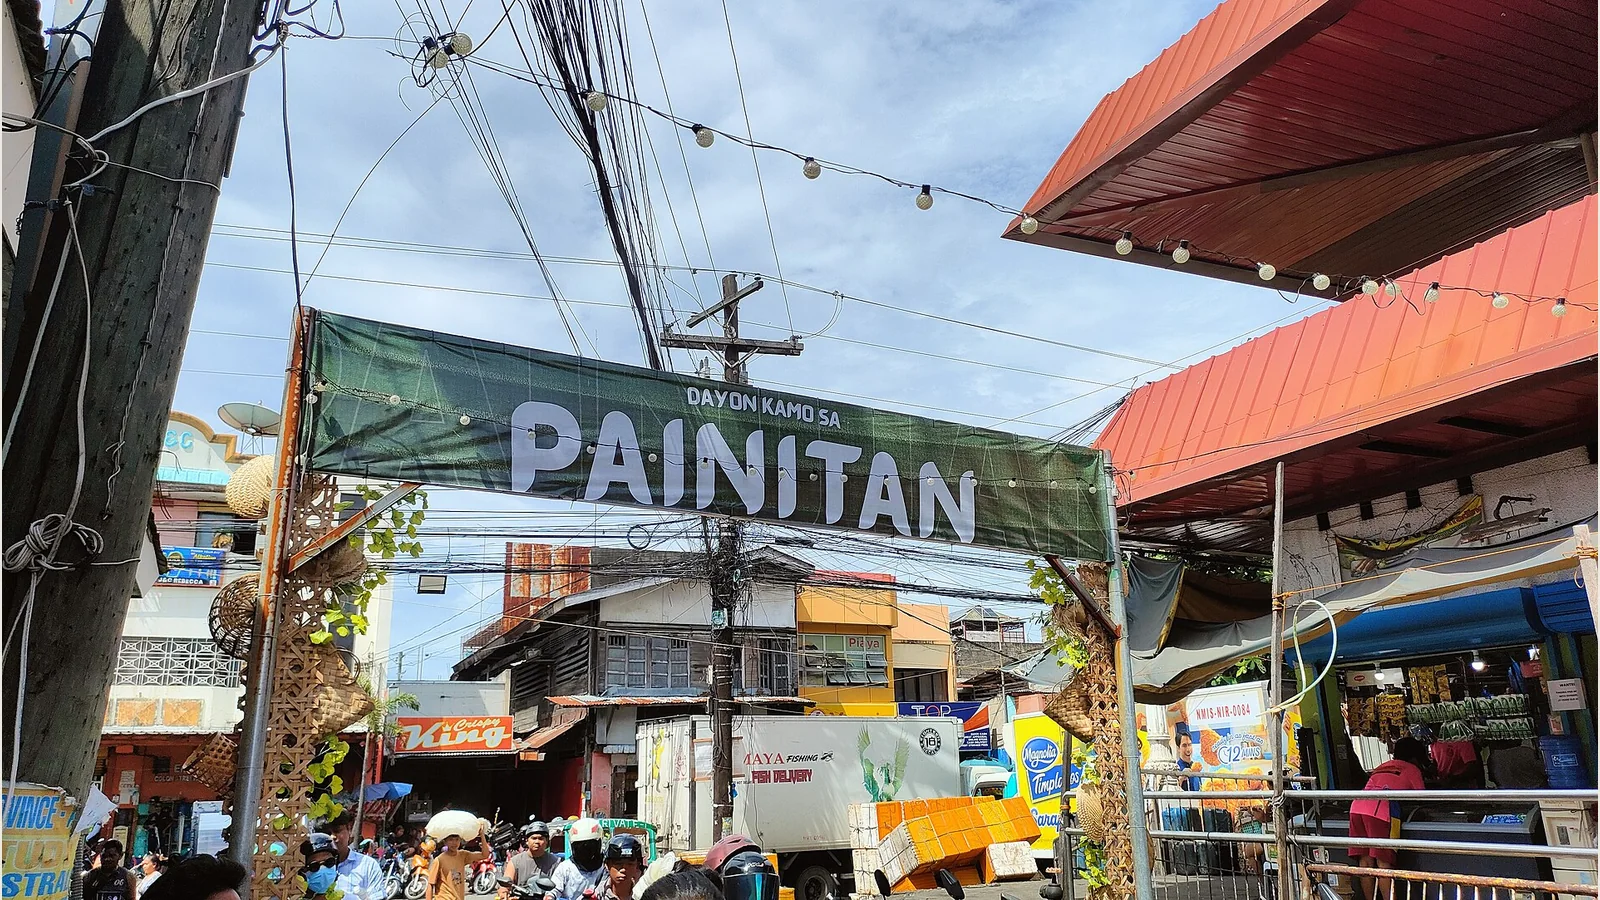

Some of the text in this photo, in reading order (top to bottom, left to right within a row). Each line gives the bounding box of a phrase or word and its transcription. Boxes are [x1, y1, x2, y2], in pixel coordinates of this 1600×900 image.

[687, 386, 841, 429] DAYON KAMO SA
[510, 401, 976, 544] PAINITAN
[173, 577, 204, 585] REBECCA
[849, 637, 880, 650] Piaya
[911, 705, 951, 717] TOP
[1196, 703, 1251, 720] NMIS-NIR-0084
[453, 718, 500, 732] Crispy
[403, 721, 511, 750] King
[786, 754, 818, 763] FISHING
[1024, 743, 1057, 768] Magnolia
[1227, 745, 1240, 762] 12
[751, 769, 813, 784] FISH DELIVERY
